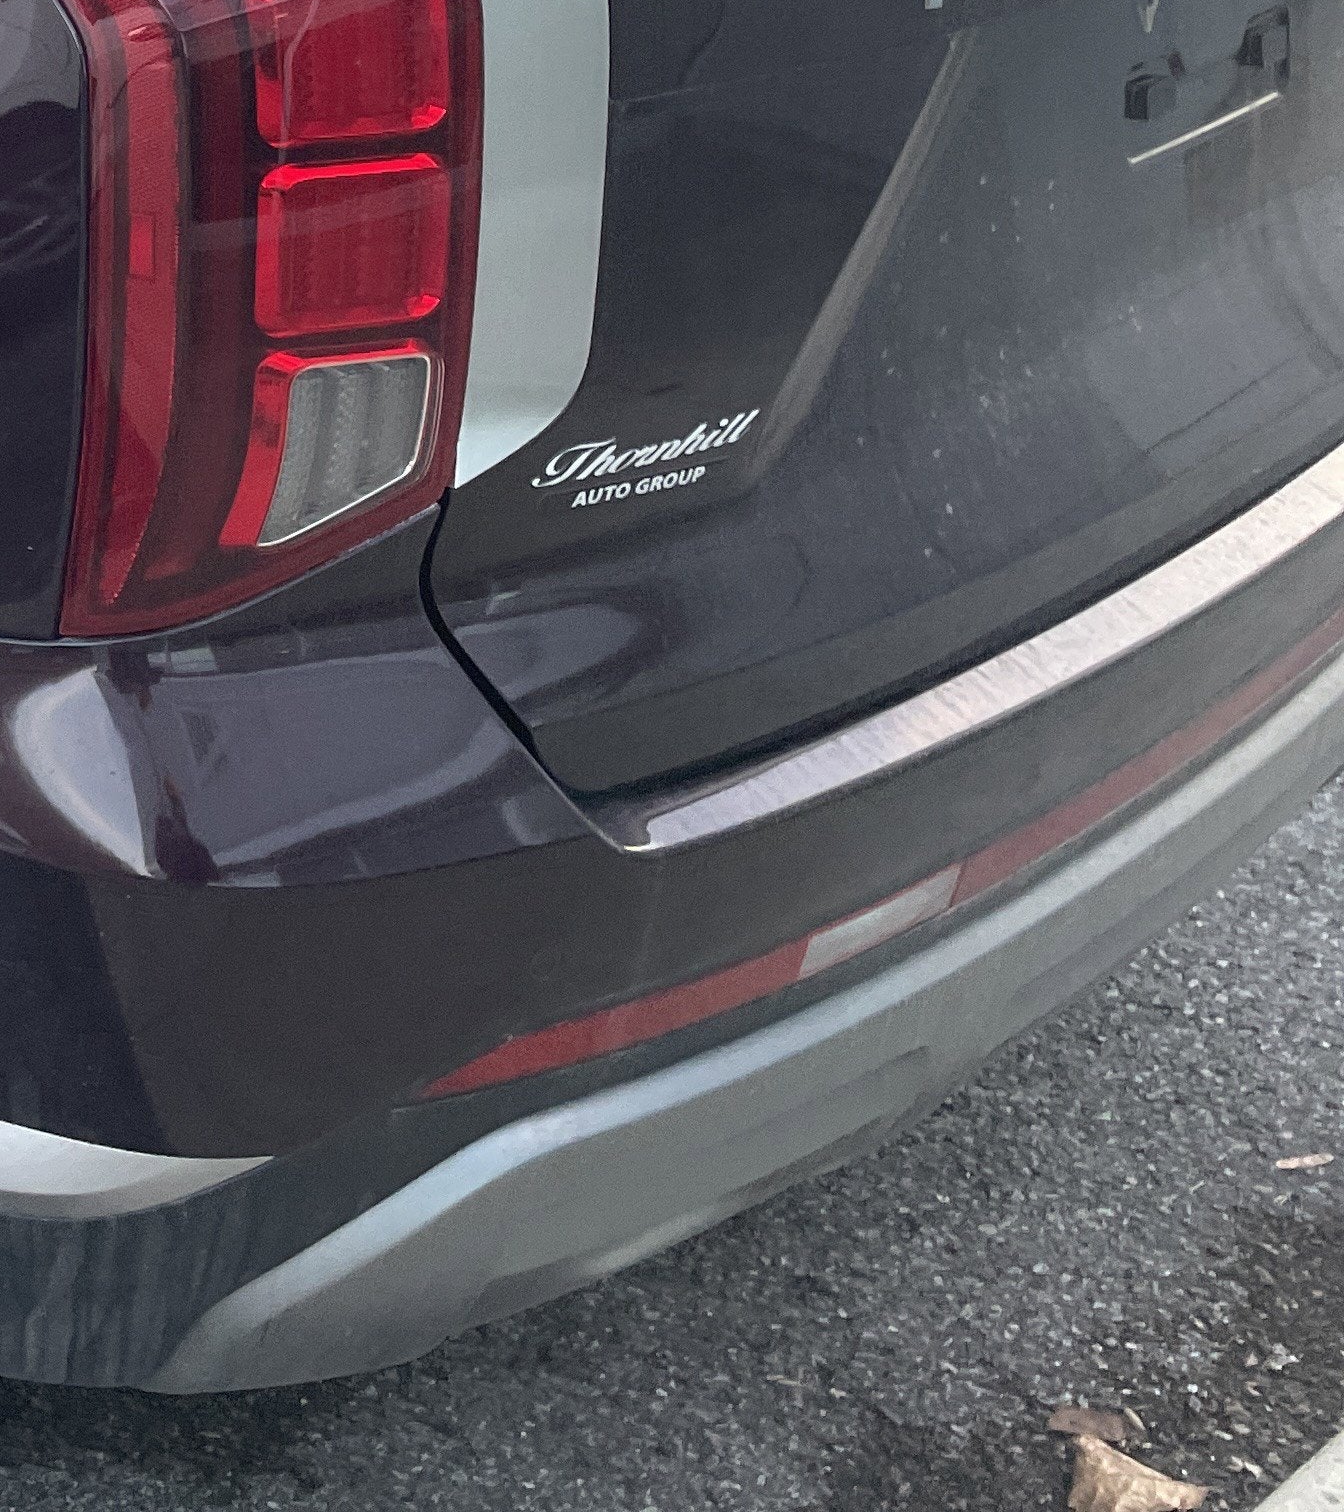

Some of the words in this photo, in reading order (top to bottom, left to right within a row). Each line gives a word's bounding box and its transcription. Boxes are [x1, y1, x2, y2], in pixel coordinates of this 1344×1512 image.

[531, 407, 761, 488] Thornhill
[570, 482, 632, 509] AUTO
[634, 465, 707, 496] GROUP
